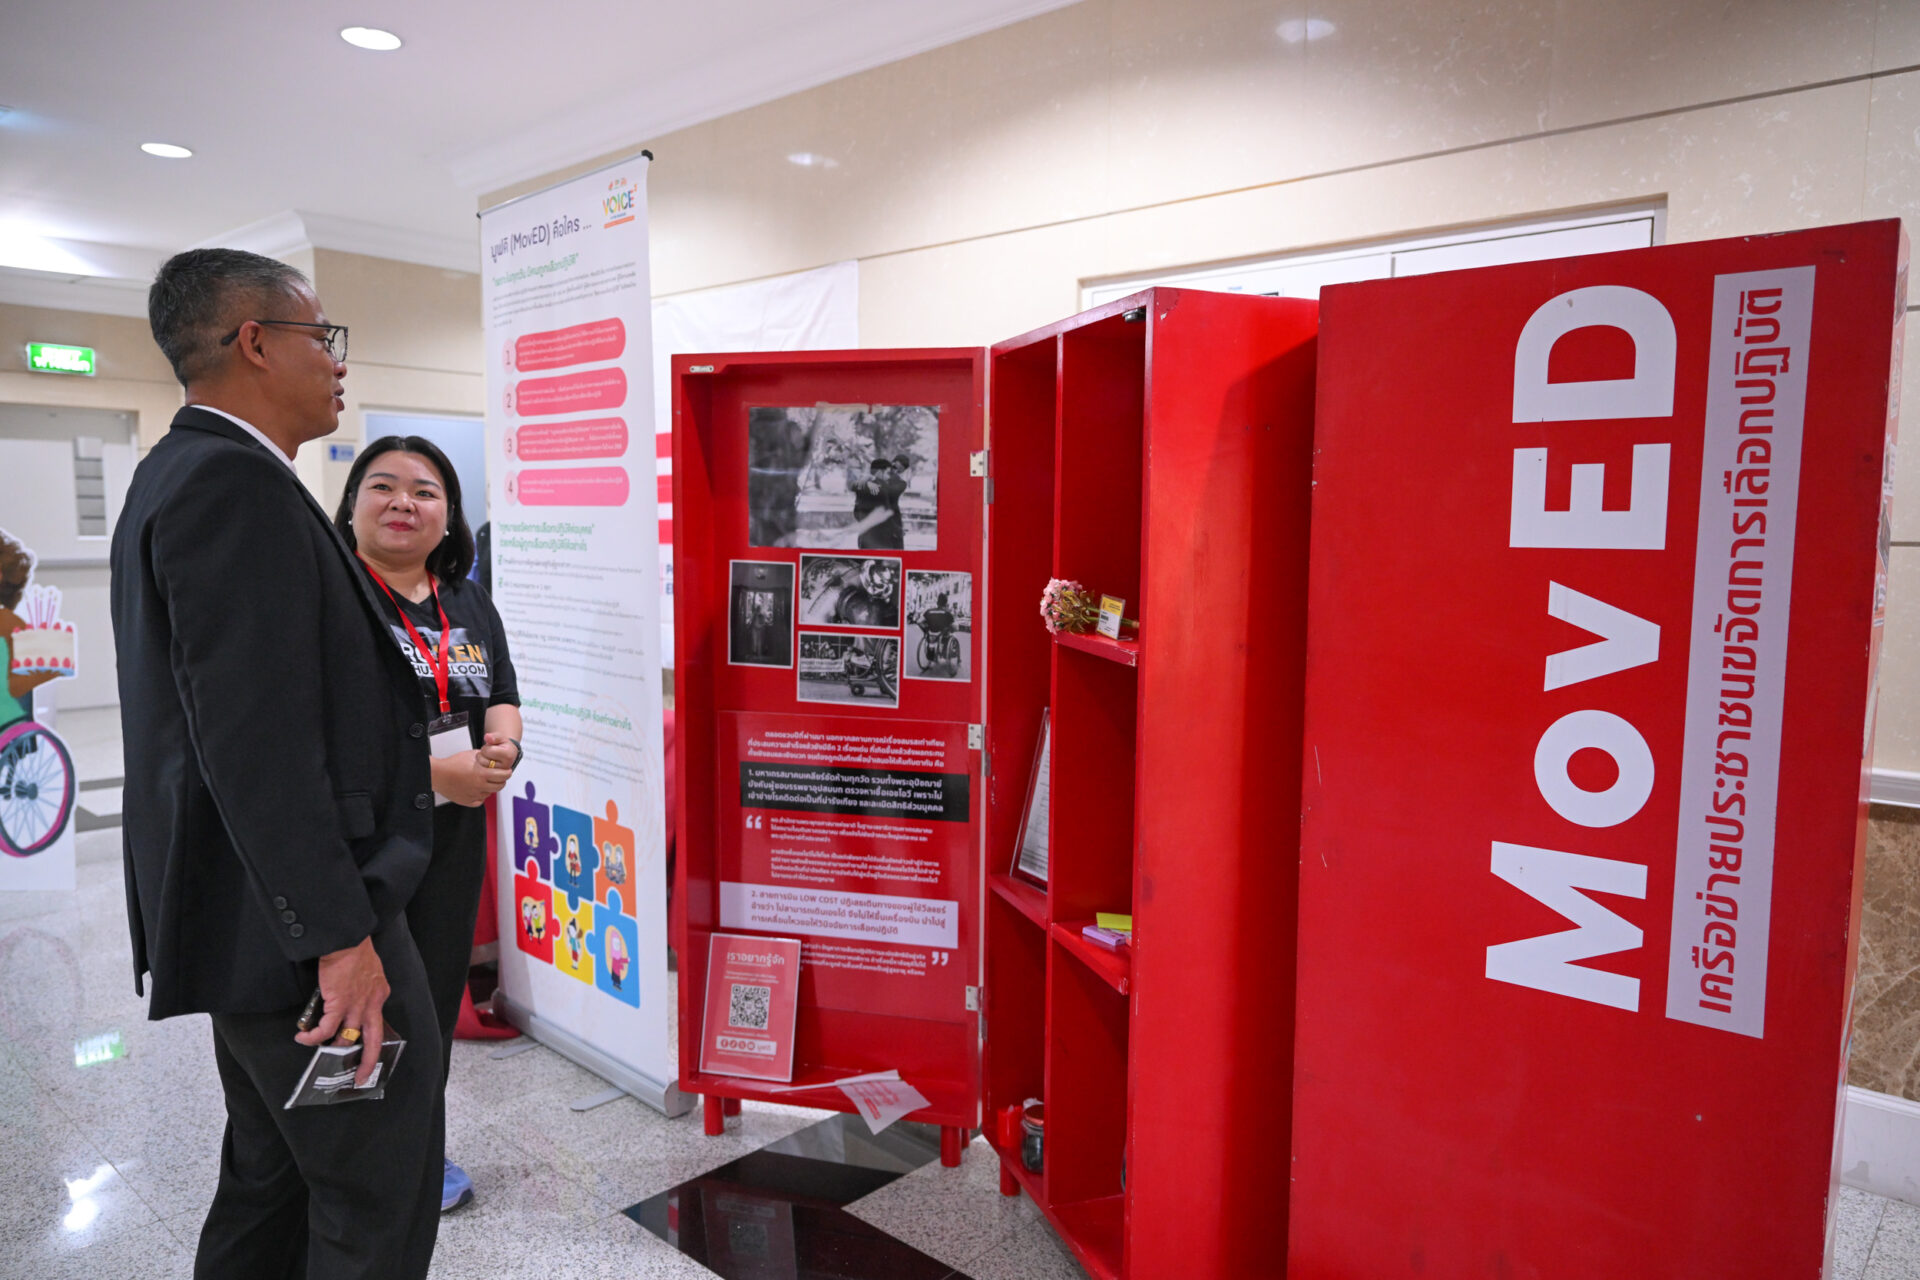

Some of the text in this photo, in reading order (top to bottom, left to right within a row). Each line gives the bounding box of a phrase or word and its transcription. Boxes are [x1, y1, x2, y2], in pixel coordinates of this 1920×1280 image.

[799, 894, 817, 903] LOW
[818, 895, 839, 904] COST
[1485, 284, 1678, 1013] MovED
[1691, 287, 1791, 1014] เครือข่ายประชาชนขจัดการเลือกปฏิบัติ
